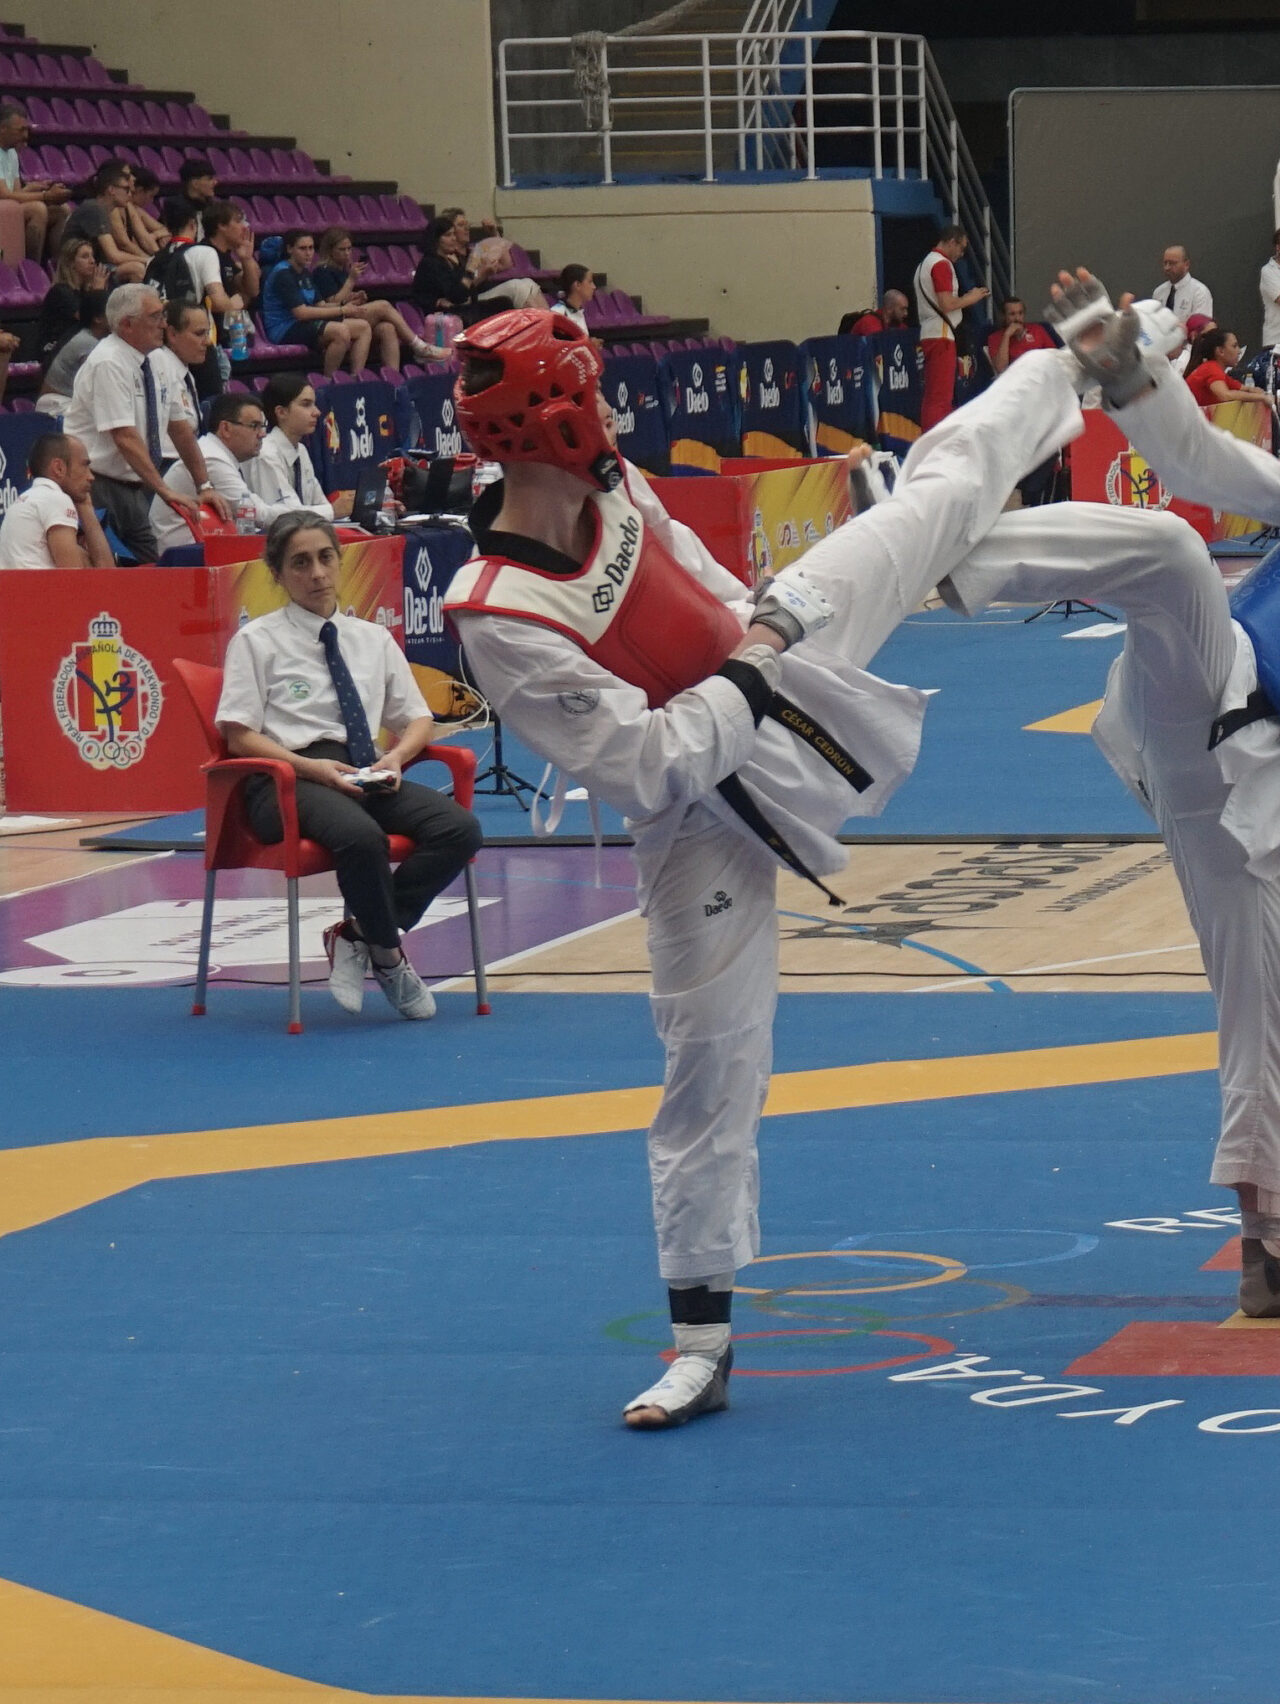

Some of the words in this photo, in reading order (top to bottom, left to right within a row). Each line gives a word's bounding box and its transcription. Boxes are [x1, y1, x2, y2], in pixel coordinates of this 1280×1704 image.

[604, 515, 640, 587] Daedo
[64, 720, 85, 743] REAL
[124, 650, 138, 662] DE
[138, 657, 160, 719] TAEKWONDO
[704, 896, 733, 917] Daedo
[1055, 1399, 1185, 1425] Y
